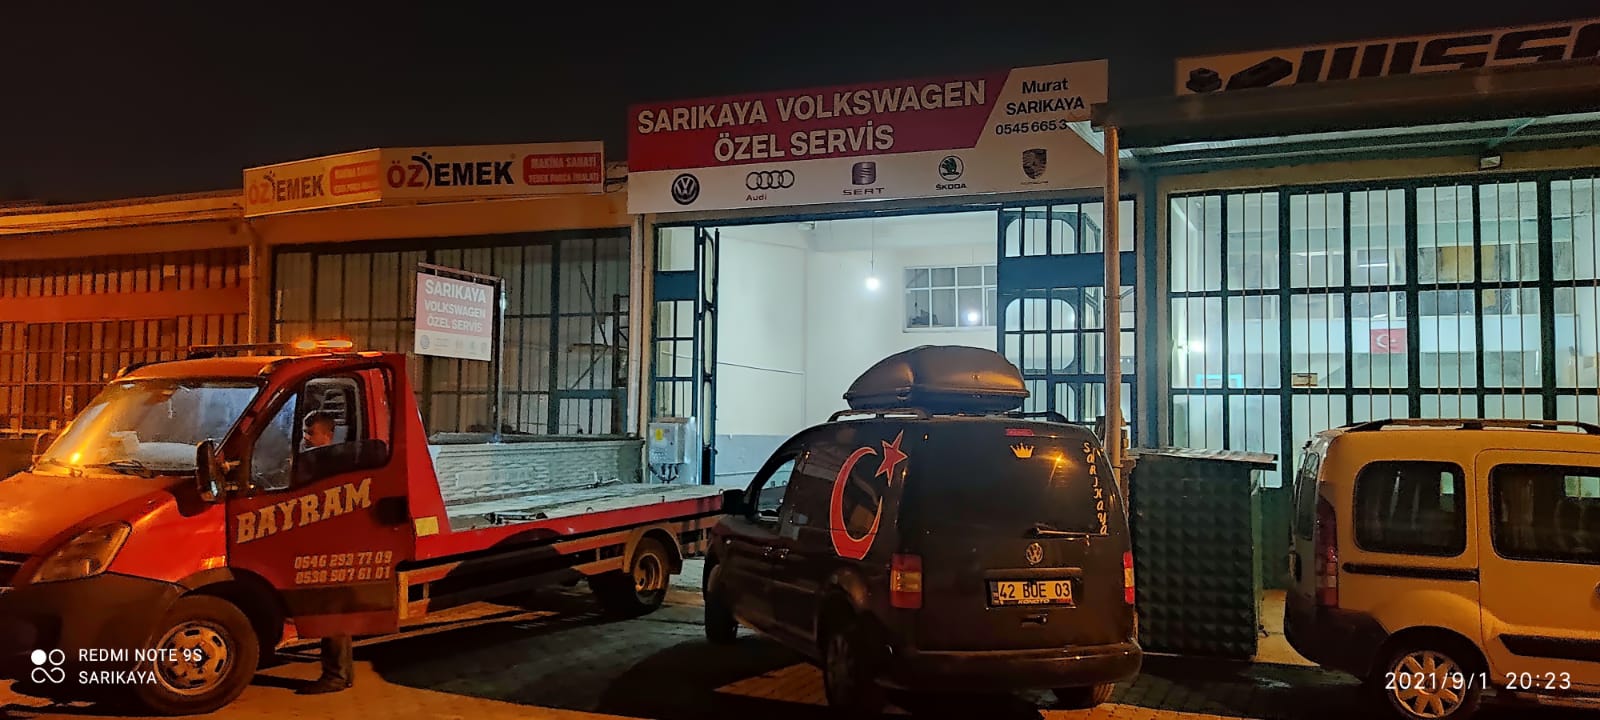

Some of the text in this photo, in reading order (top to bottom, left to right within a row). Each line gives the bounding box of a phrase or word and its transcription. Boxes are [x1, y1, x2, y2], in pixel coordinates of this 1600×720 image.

[1022, 78, 1068, 94] Murat
[638, 80, 985, 133] SARIKAYA VOLKSWAGEN
[1006, 96, 1085, 115] SARIKAYA
[995, 122, 1029, 135] 0545
[1031, 120, 1057, 133] 665
[714, 121, 894, 162] ÖZEL SERVİS
[387, 160, 424, 188] ÖZ
[425, 279, 486, 304] SARIKAYA
[424, 299, 486, 319] VOLKSWAGEN
[236, 478, 372, 543] BAYRAM
[294, 555, 327, 569] 0546
[358, 551, 372, 564] 77
[375, 550, 392, 564] 09
[358, 567, 371, 580] 61
[375, 566, 390, 579] 01
[1000, 584, 1015, 598] 42
[1055, 583, 1070, 597] 03
